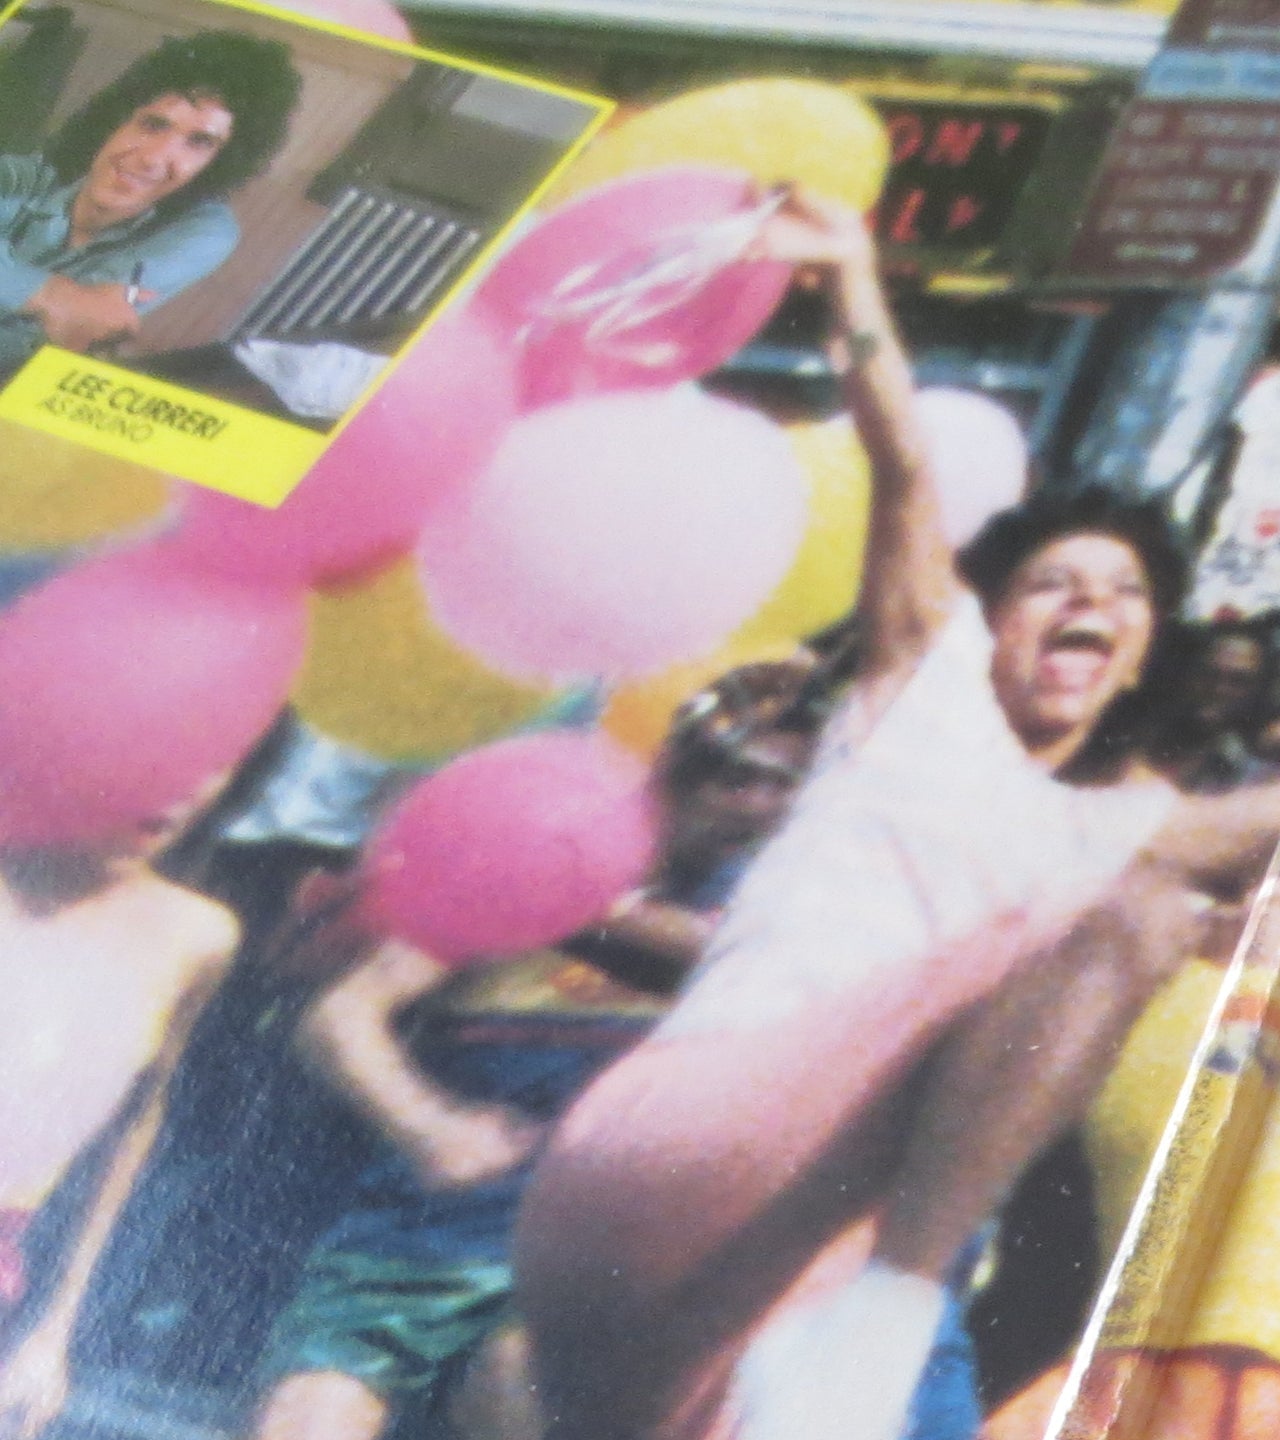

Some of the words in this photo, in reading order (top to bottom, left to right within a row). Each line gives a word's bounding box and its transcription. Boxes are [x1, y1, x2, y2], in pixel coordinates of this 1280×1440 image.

[37, 394, 74, 417] AS
[69, 402, 154, 443] BRUNO
[57, 369, 112, 401] LEE
[108, 386, 229, 441] CURRERI
